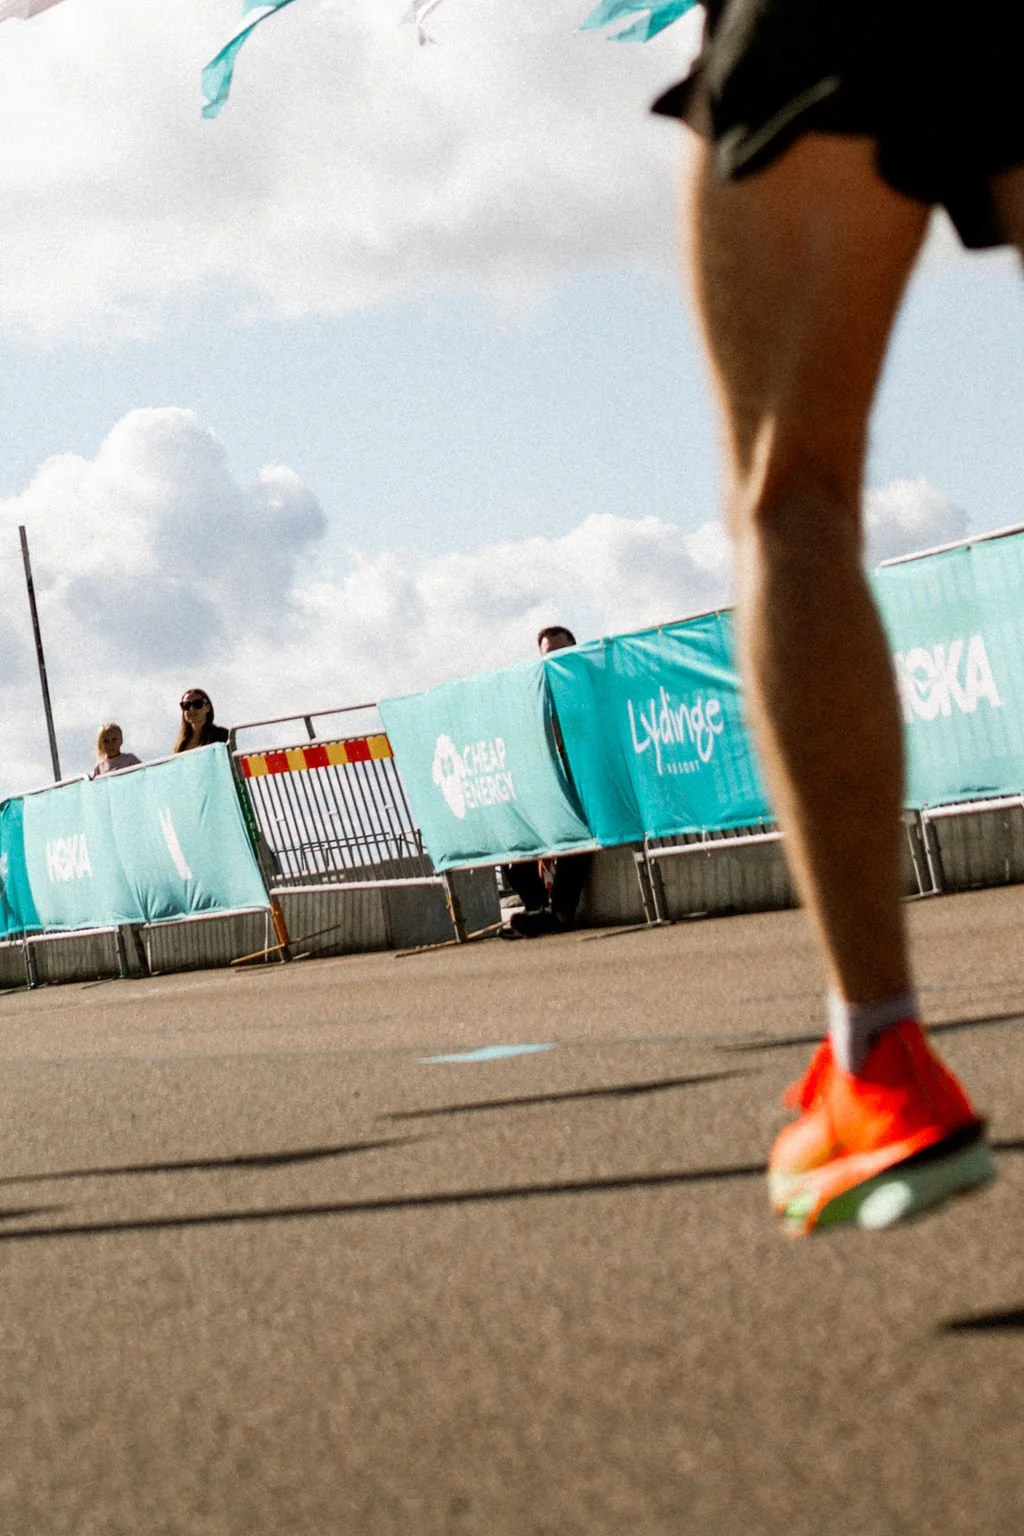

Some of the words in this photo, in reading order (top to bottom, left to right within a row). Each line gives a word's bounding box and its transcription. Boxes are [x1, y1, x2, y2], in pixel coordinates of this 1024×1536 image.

[628, 686, 723, 775] Lydinge
[463, 737, 506, 775] CHEAP
[462, 770, 517, 809] ENERGY
[46, 832, 94, 882] HOKA
